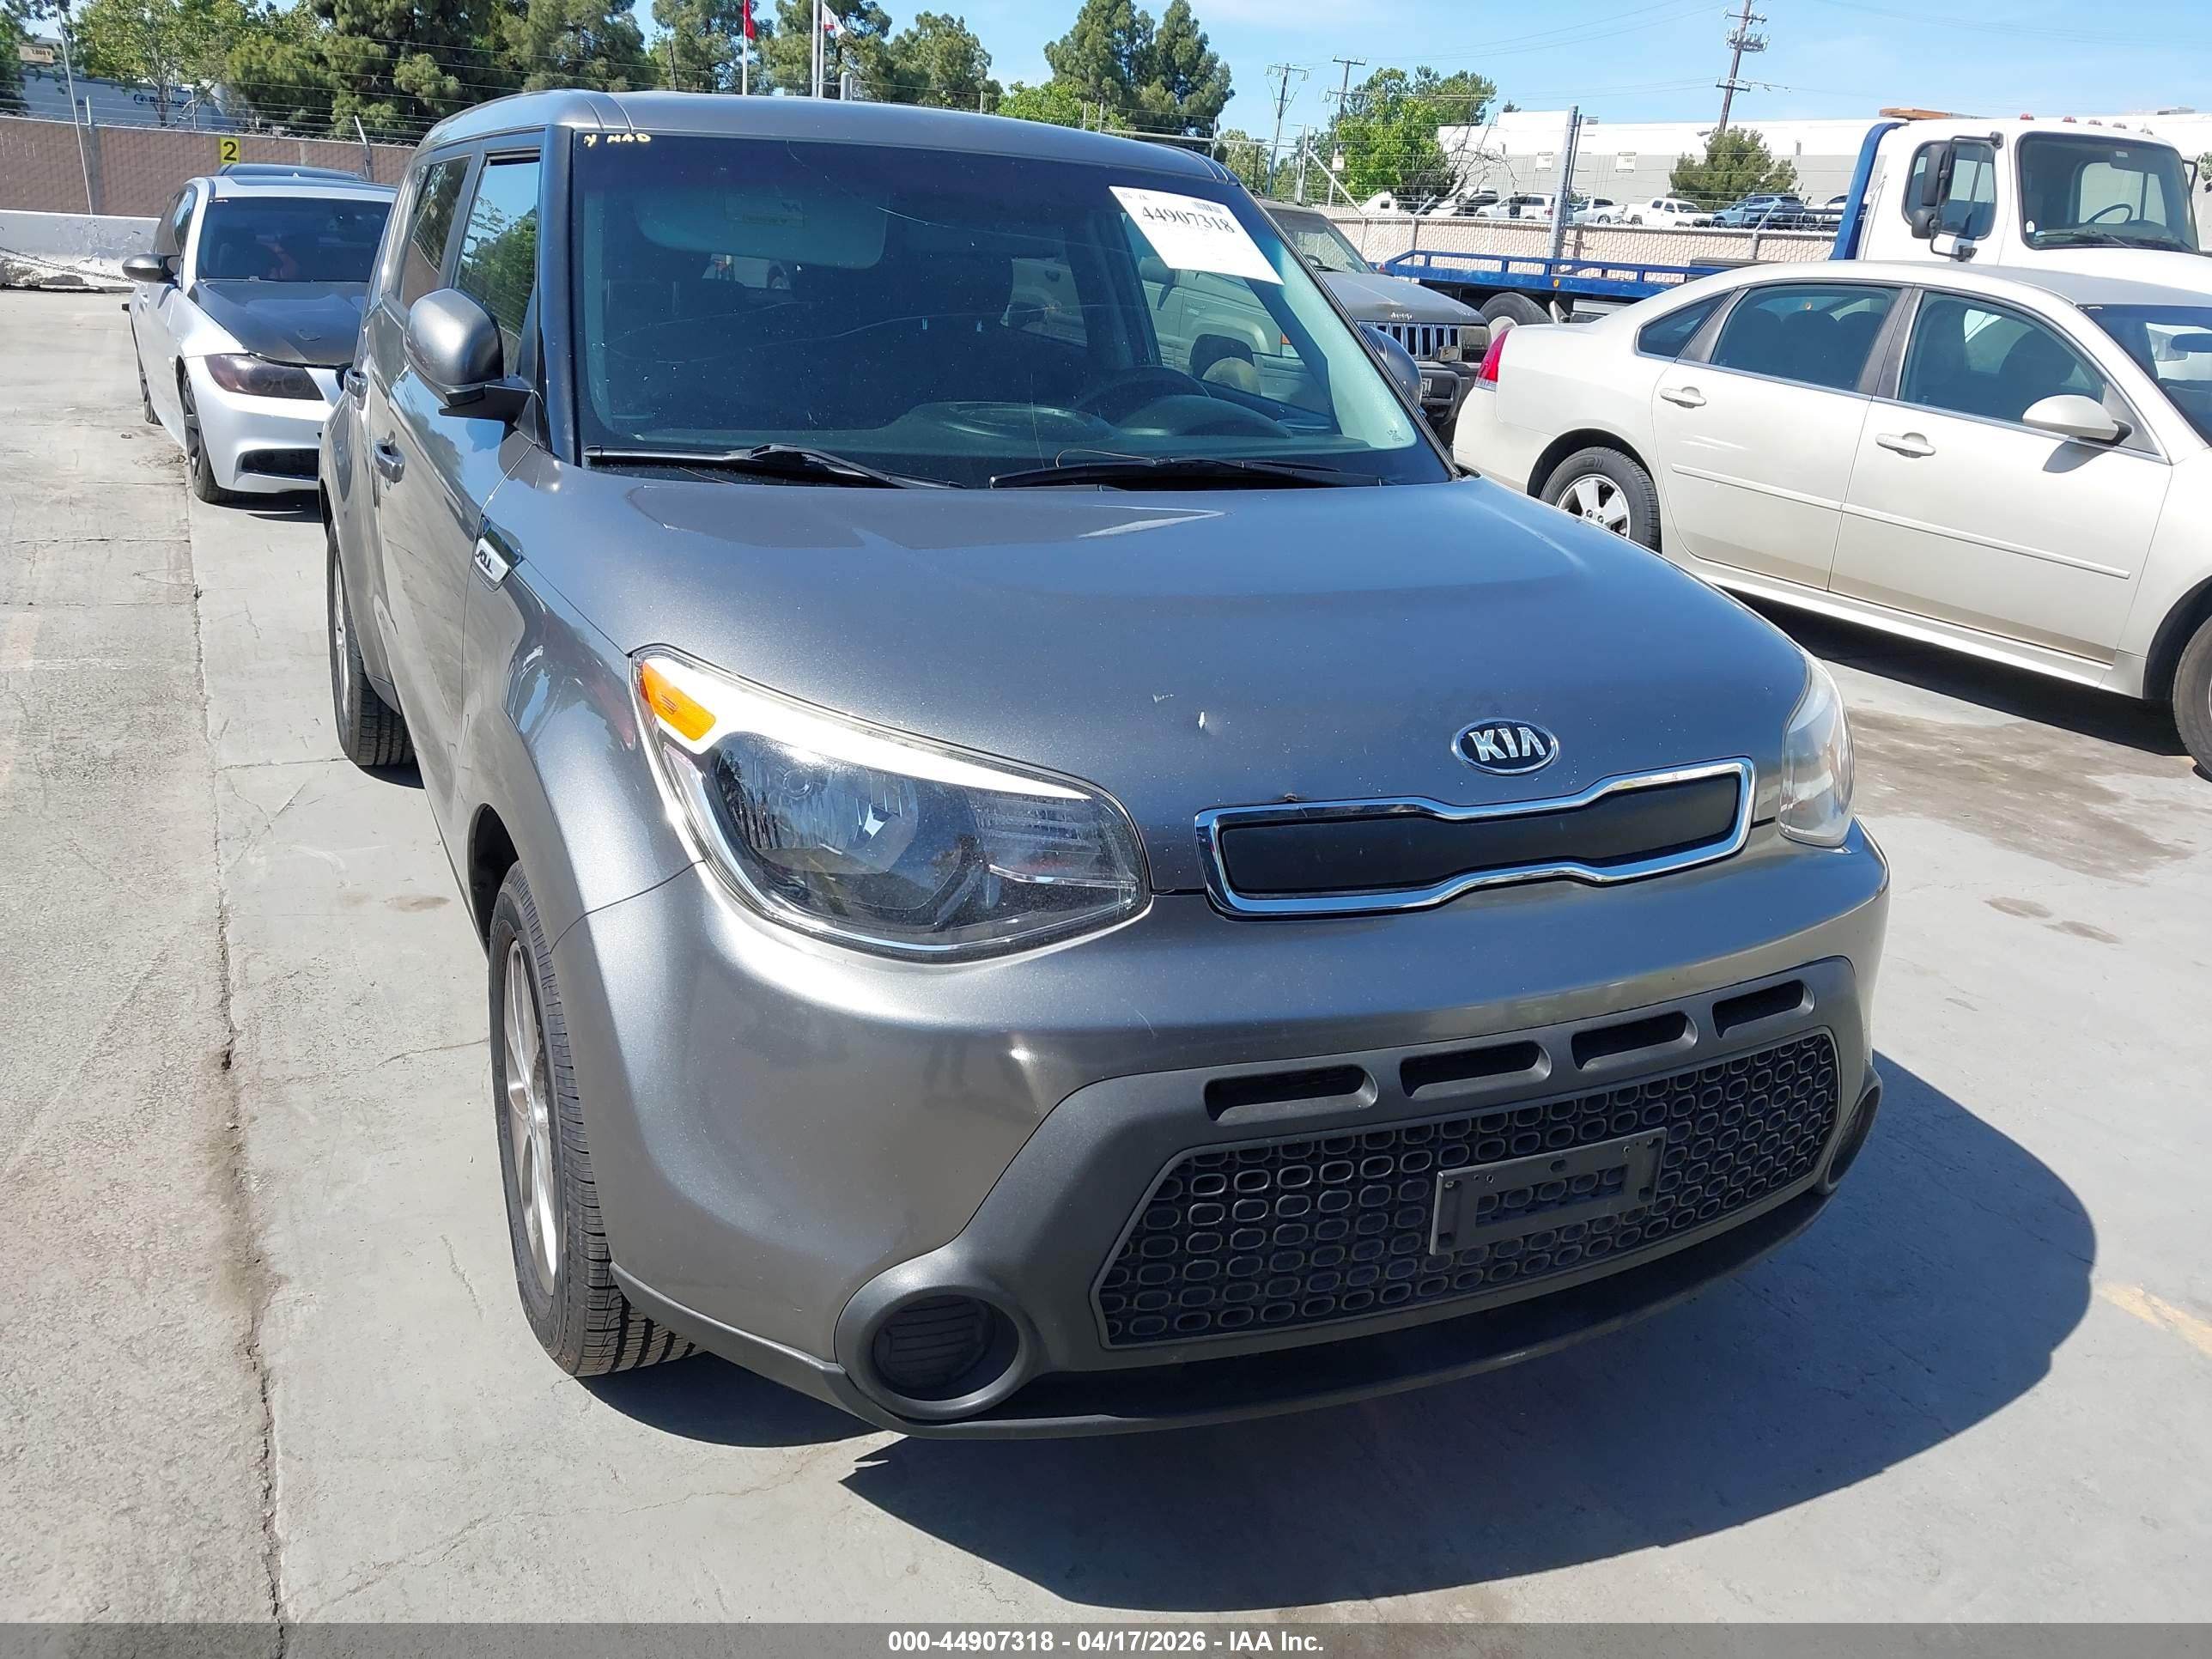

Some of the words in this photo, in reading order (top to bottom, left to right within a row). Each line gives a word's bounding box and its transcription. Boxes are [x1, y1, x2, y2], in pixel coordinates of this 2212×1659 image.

[223, 141, 237, 161] 2
[1142, 205, 1235, 234] 44907318
[1468, 726, 1547, 762] KIA
